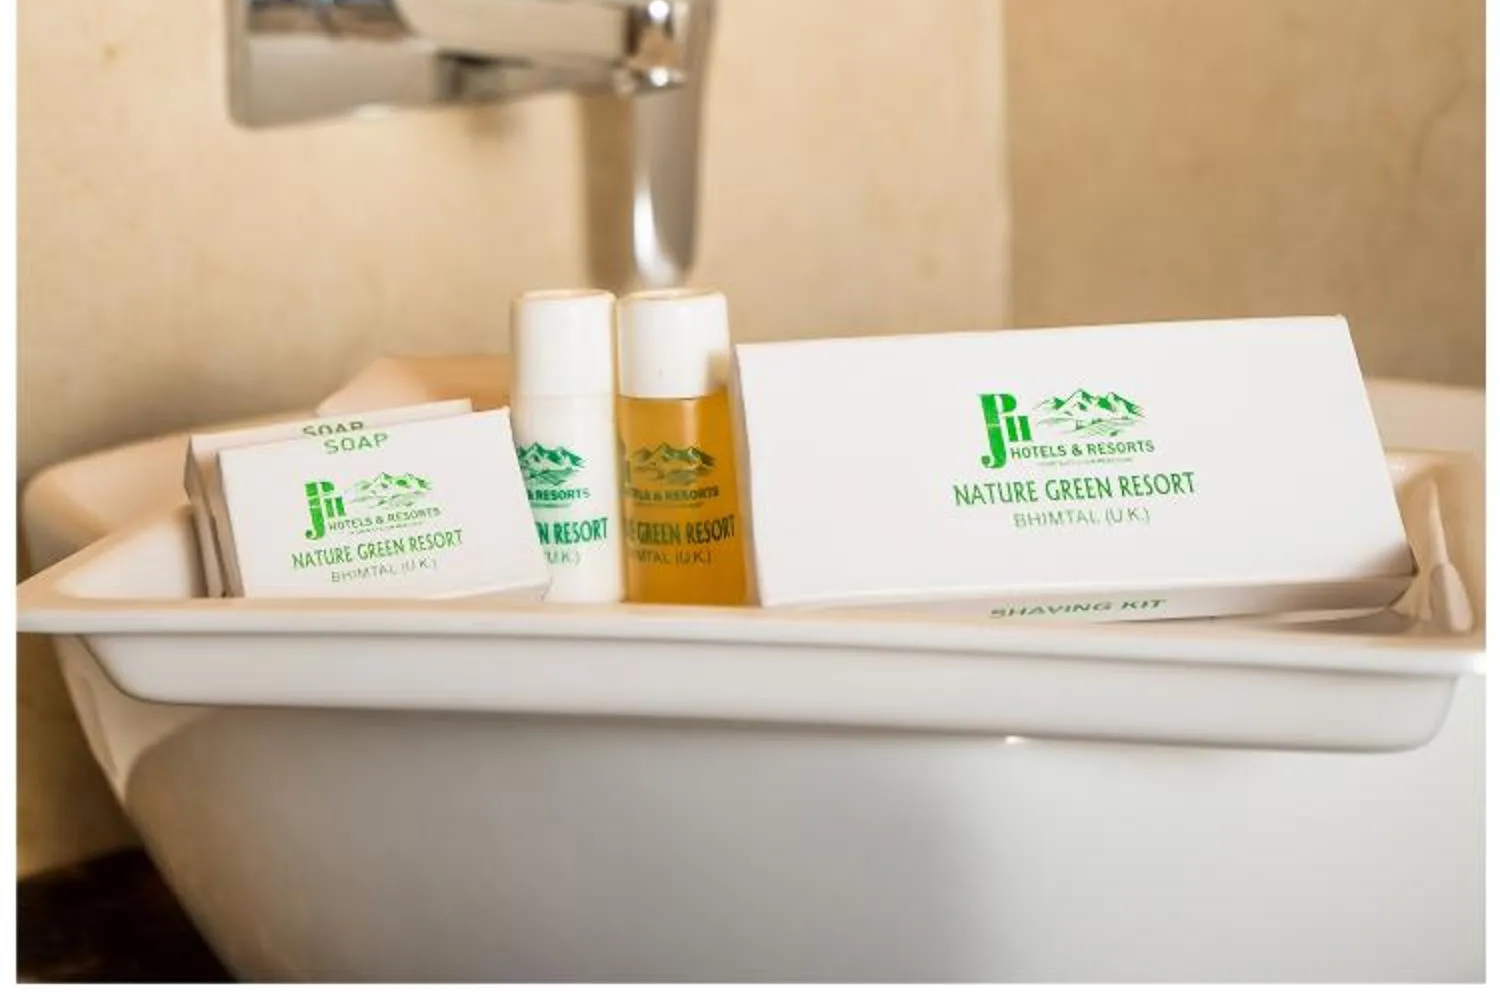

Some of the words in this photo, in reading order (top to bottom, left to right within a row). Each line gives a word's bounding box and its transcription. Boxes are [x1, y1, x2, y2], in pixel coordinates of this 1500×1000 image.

[324, 433, 389, 455] SOAP
[1009, 444, 1067, 460] HOTELS
[1072, 443, 1082, 457] &
[1087, 439, 1155, 456] RESORTS
[535, 487, 592, 501] RESORTS
[952, 480, 1039, 507] NATURE
[1045, 477, 1113, 502] GREEN
[1119, 471, 1195, 498] RESORT
[328, 516, 373, 531] HOTELS
[387, 506, 441, 522] RESORTS
[637, 520, 682, 546] GREEN
[685, 513, 735, 545] RESORT
[1013, 509, 1101, 529] BHIMTAL
[553, 516, 608, 545] RESORT
[291, 545, 354, 571] NATURE
[357, 537, 405, 561] GREEN
[409, 529, 464, 552] RESORT
[330, 564, 398, 584] BHIMTAL
[989, 600, 1113, 618] SHAVING
[1119, 599, 1168, 611] KIT
